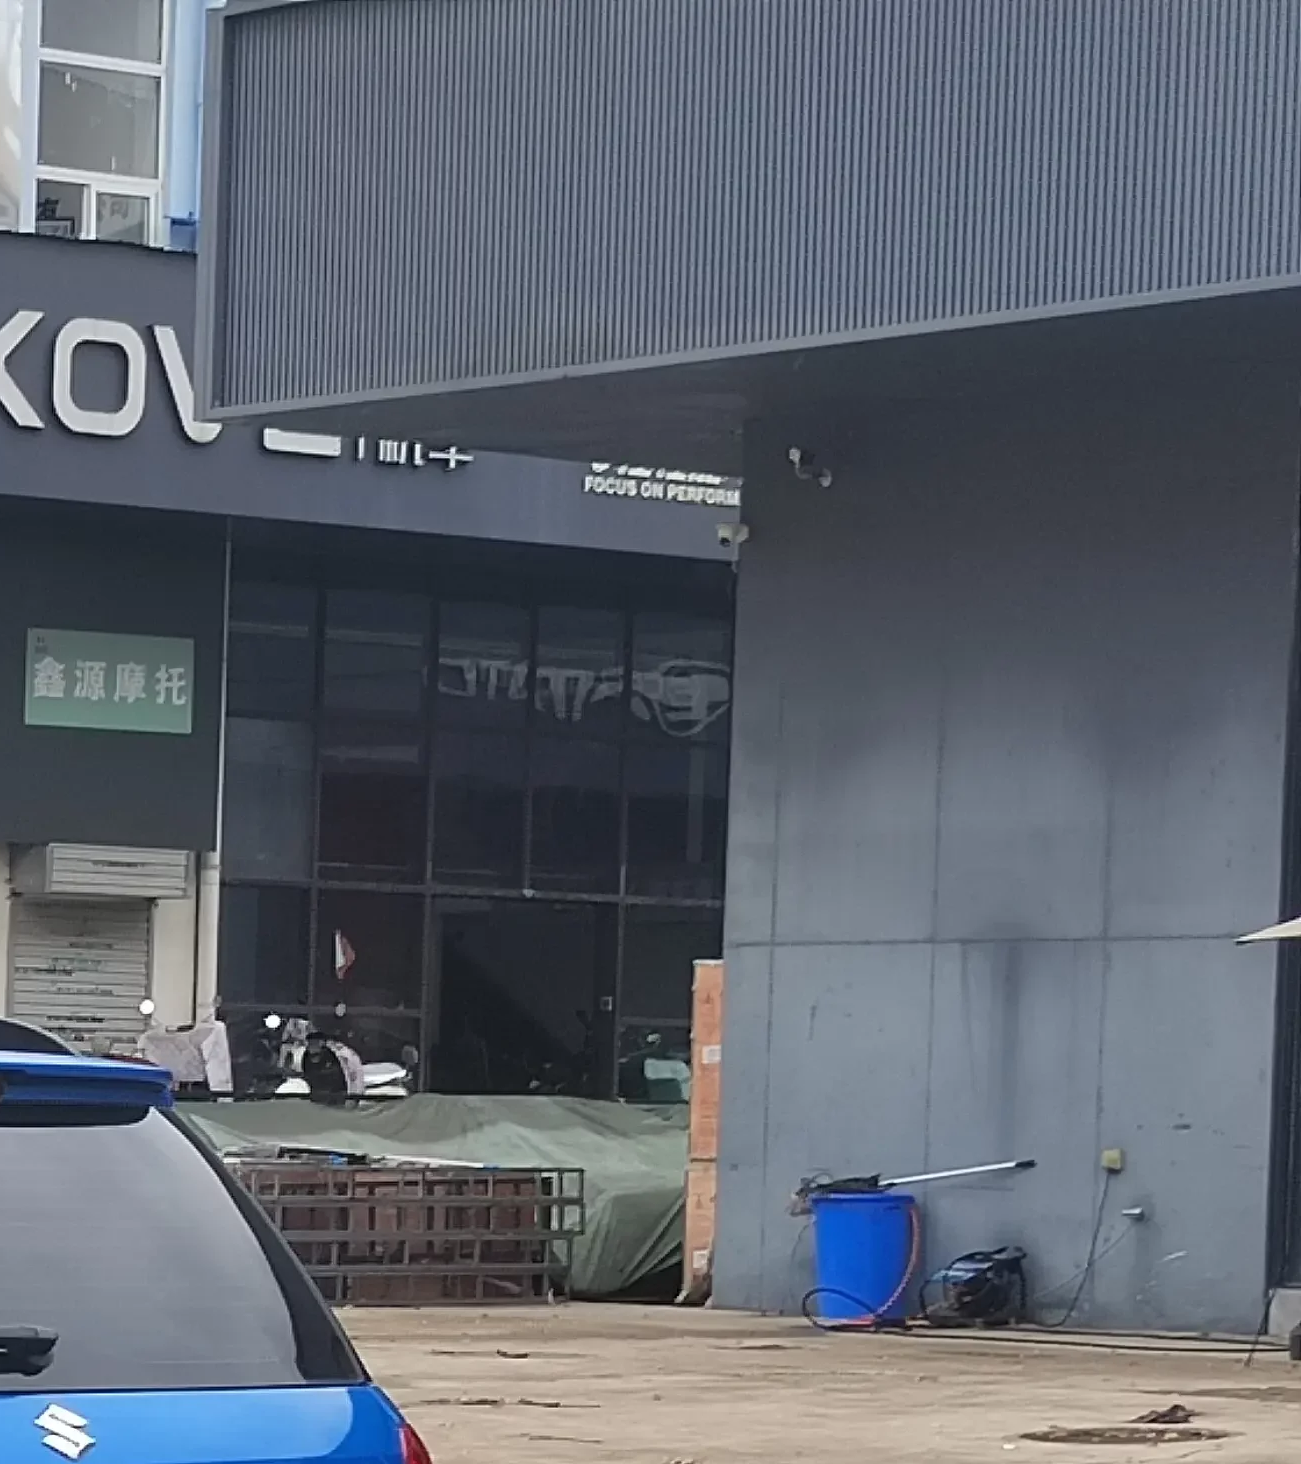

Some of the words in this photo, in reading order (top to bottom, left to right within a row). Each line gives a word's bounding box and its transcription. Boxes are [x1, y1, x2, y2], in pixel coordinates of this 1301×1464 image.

[584, 475, 637, 497] FOCUS
[640, 480, 664, 499] ON
[33, 656, 187, 706] 鑫源摩托
